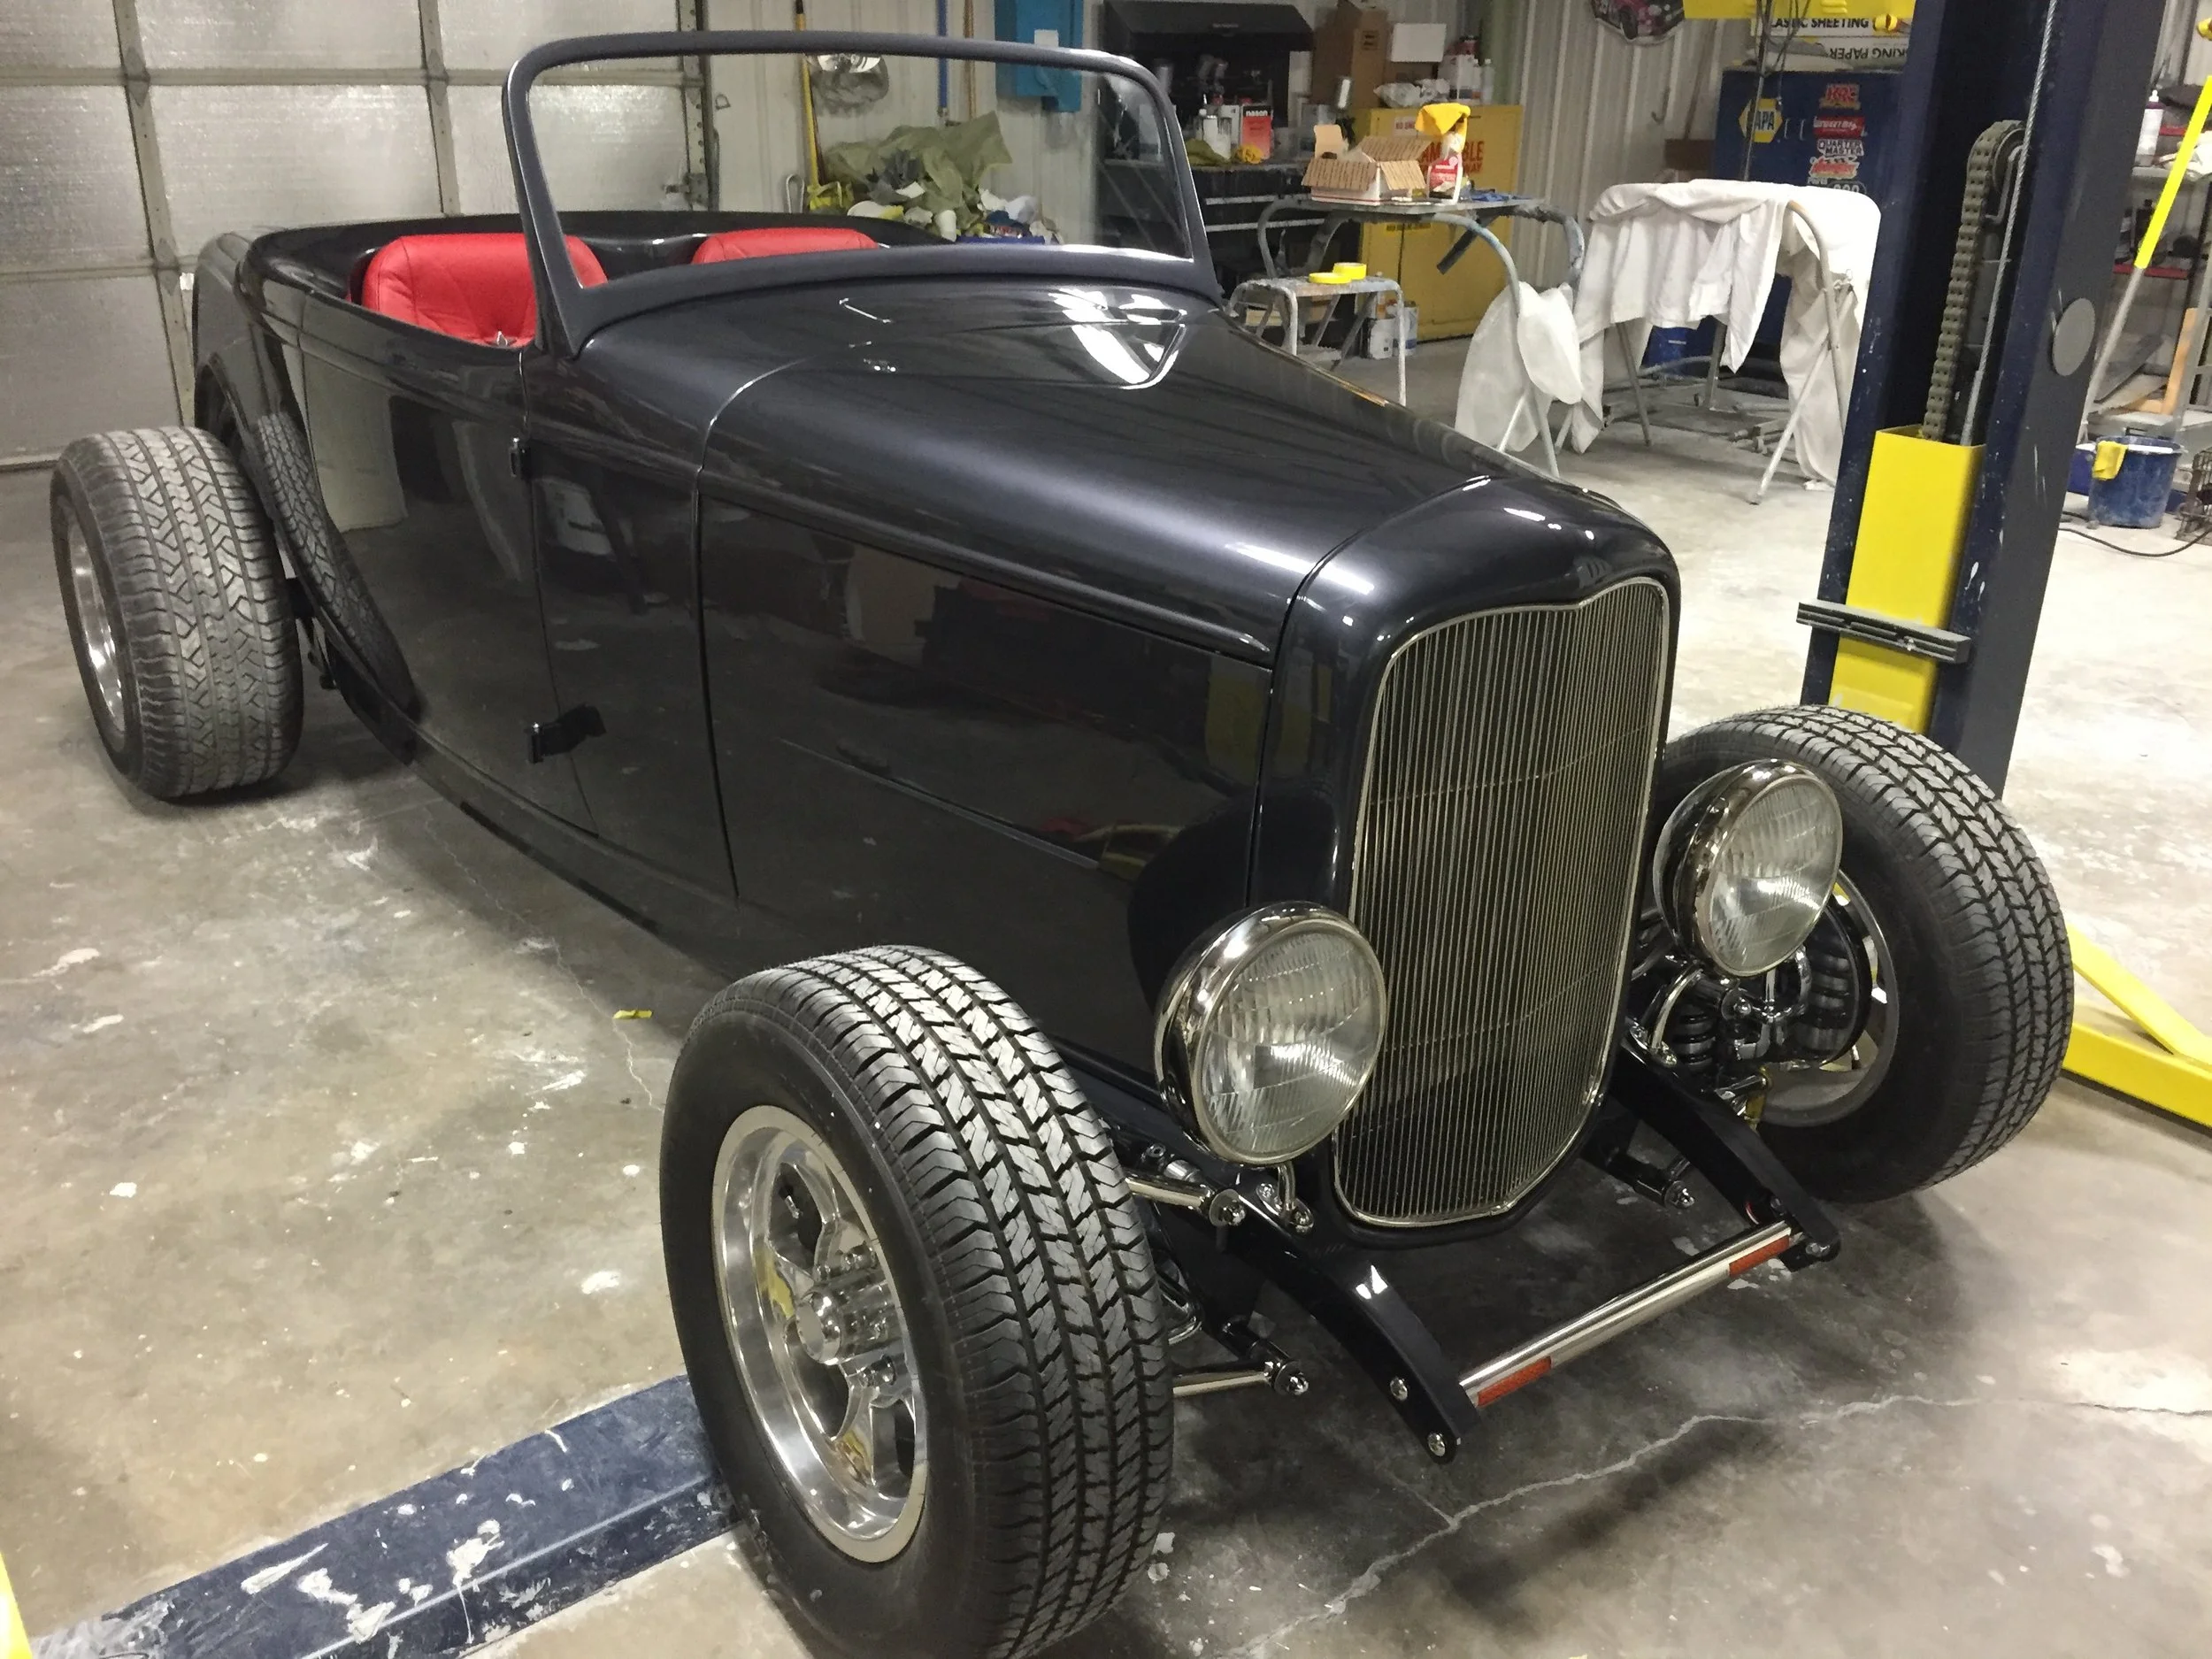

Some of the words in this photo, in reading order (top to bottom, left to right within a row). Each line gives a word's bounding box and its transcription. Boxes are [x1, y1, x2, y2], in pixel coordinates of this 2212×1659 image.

[1811, 18, 1869, 28] SHEETING
[1829, 47, 1868, 60] PAPER
[1825, 146, 1863, 156] MASTER
